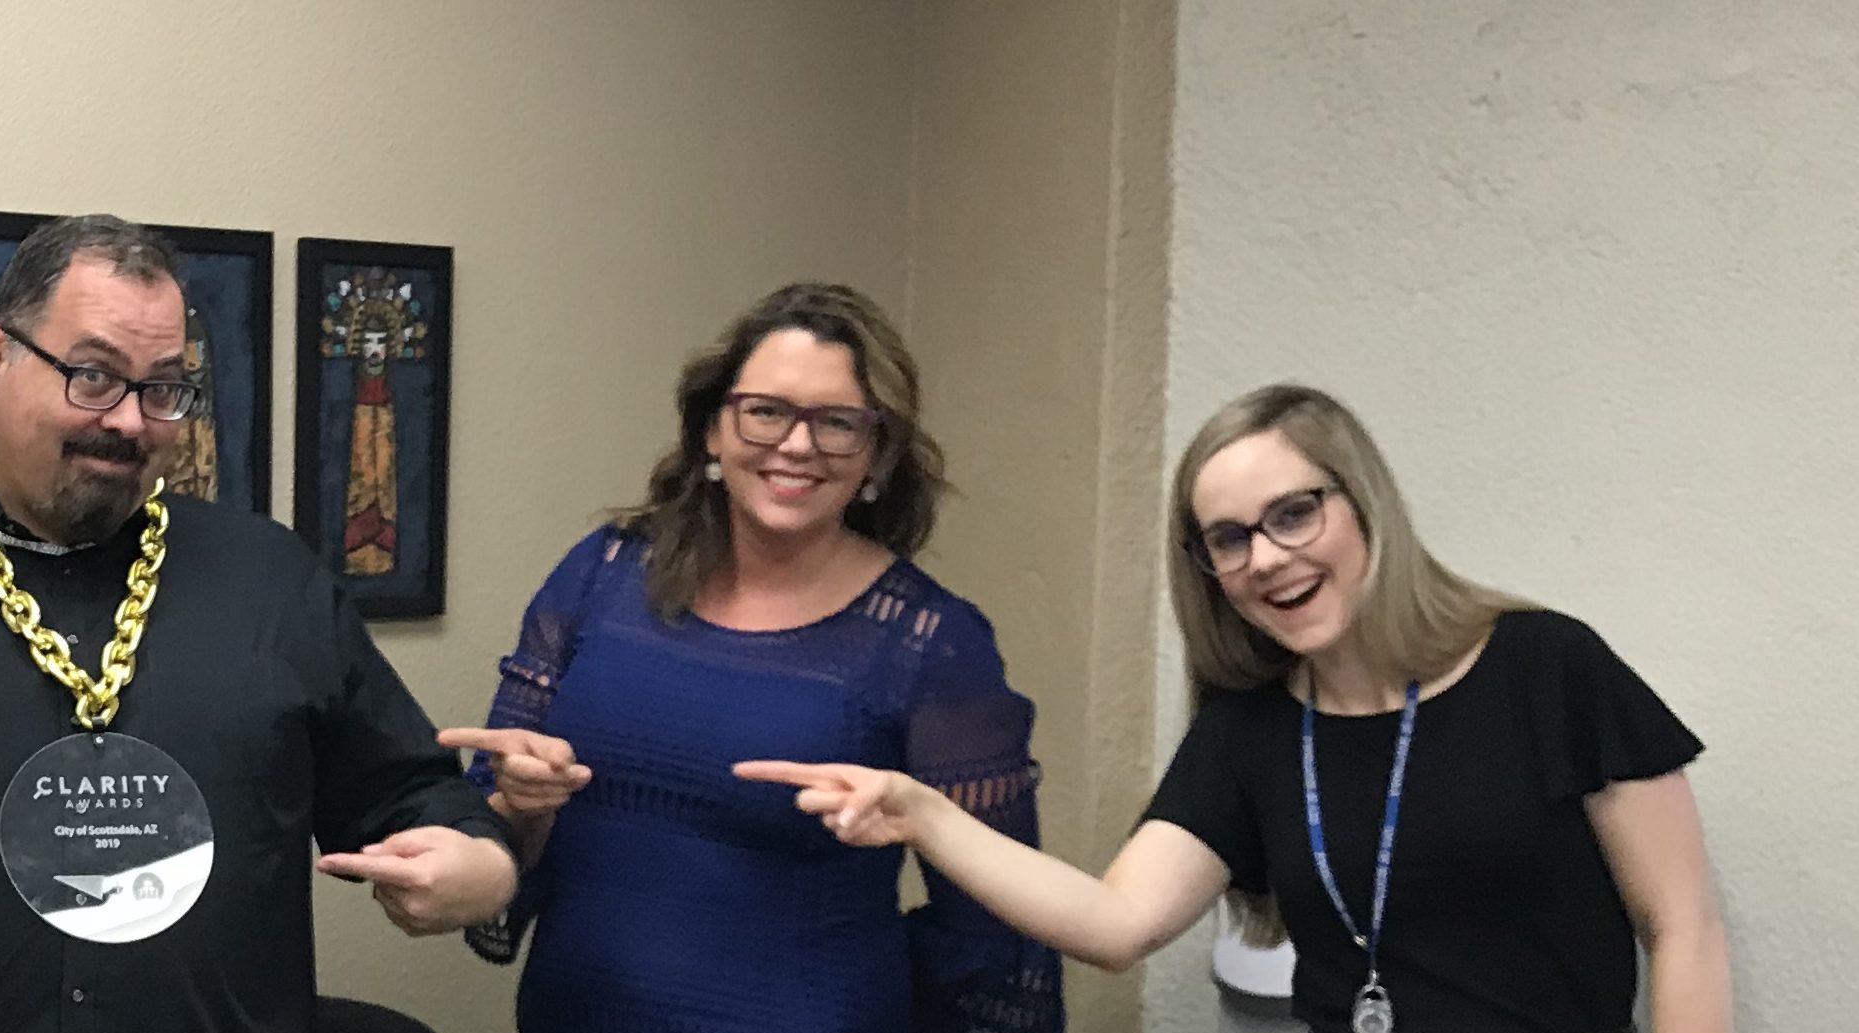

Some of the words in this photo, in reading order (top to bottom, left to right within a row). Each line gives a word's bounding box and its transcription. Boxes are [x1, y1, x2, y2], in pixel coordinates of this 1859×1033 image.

[33, 775, 169, 799] CLARITY
[65, 798, 144, 811] AWARDS
[54, 825, 76, 838] City
[76, 825, 88, 836] of
[88, 824, 143, 836] Scottsdale,
[143, 823, 159, 835] AZ
[95, 838, 121, 849] 2019
